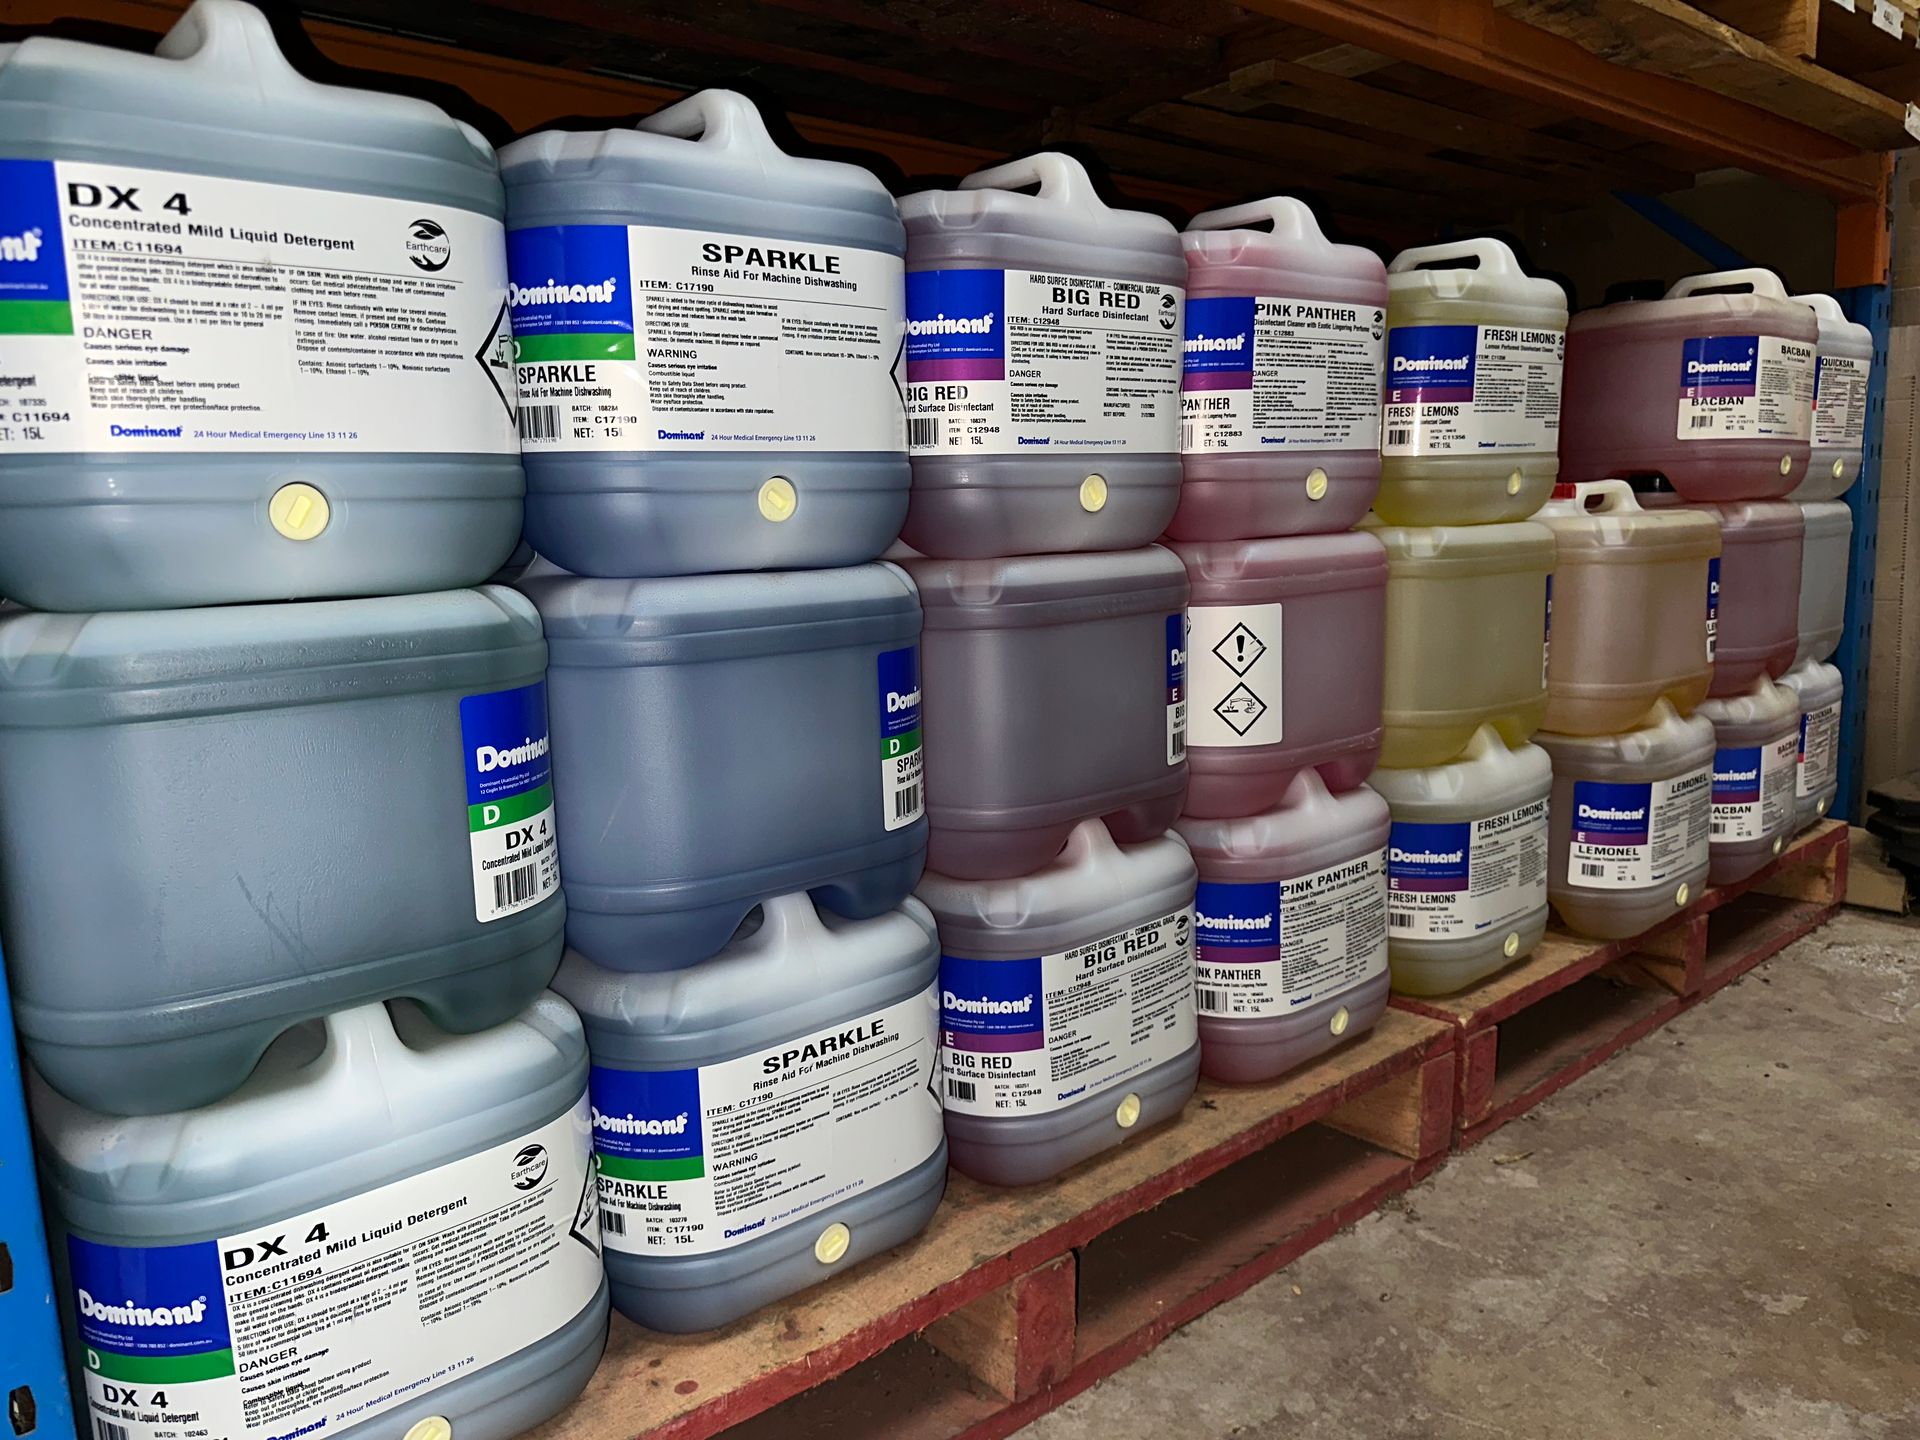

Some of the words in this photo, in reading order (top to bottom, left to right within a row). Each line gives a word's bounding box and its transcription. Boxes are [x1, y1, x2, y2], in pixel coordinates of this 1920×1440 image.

[67, 182, 142, 212] DX
[162, 192, 192, 216] 4
[69, 214, 181, 235] Concentrated
[188, 223, 224, 239] Mild
[230, 228, 277, 246] Liquid
[284, 232, 355, 251] Detergent
[406, 241, 448, 254] Earthcare
[702, 242, 841, 274] SPARKLE
[639, 280, 672, 289] ITEM:
[676, 282, 714, 292] C17190
[692, 266, 720, 278] Rinse
[723, 268, 739, 279] Aid
[743, 270, 759, 281] For
[762, 272, 801, 285] Machine
[804, 276, 858, 291] Dishwashing
[1029, 274, 1046, 284] HARD
[1047, 275, 1067, 287] SURFCE
[1069, 278, 1105, 290] DISINFECTANT
[1113, 281, 1144, 294] COMMERCIAL
[1145, 285, 1161, 296] GRADE
[1052, 287, 1090, 306] BIG
[1099, 292, 1141, 310] RED
[1007, 316, 1031, 324] ITEM:
[1033, 317, 1060, 325] C12948
[1042, 305, 1063, 316] Hard
[1067, 307, 1100, 318] Surface
[1102, 310, 1149, 322] Disinfectant
[1255, 303, 1292, 317] PINK
[1297, 306, 1356, 322] PANTHER
[84, 327, 152, 340] DANGER
[1484, 329, 1518, 342] FRESH
[1521, 332, 1556, 345] LEMONS
[84, 343, 112, 352] Causes
[144, 346, 158, 354] eye
[160, 346, 190, 354] damage
[647, 349, 697, 359] WARNING
[1781, 345, 1811, 358] BACBAN
[86, 358, 114, 367] Causes
[116, 358, 133, 367] skin
[135, 359, 167, 368] irritation
[1393, 355, 1470, 372] Dominant
[1687, 360, 1752, 373] Dominant
[1821, 358, 1854, 369] QUICKSAN
[518, 365, 596, 384] SPARKLE
[1009, 370, 1042, 378] DANGER
[934, 385, 968, 401] RED
[918, 403, 946, 413] Surface
[1691, 397, 1744, 406] BACBAN
[12, 412, 70, 422] C11694
[1421, 406, 1459, 417] LEMONS
[22, 427, 45, 440] 15L
[110, 424, 183, 438] Dominant
[194, 430, 204, 439] 24
[206, 430, 227, 439] Hour
[229, 430, 262, 440] Medical
[263, 430, 306, 441] Emergency
[308, 431, 325, 440] Line
[326, 431, 336, 440] 13
[338, 431, 347, 440] 11
[348, 431, 358, 440] 26
[573, 428, 594, 438] NET:
[657, 429, 705, 440] Dominant
[967, 426, 1000, 434] C12948
[970, 436, 984, 445] 15L
[889, 739, 900, 754] D
[1713, 768, 1757, 782] ominant
[1671, 773, 1708, 794] LEMONEL
[482, 805, 501, 826] D
[1478, 817, 1509, 832] FRESH
[1512, 801, 1544, 822] LEMONS
[1579, 804, 1645, 820] Dominant
[1713, 805, 1751, 814] ACBAN
[505, 824, 534, 850] DX
[539, 818, 547, 836] 4
[1390, 848, 1463, 864] Dominant
[1578, 845, 1639, 856] LEMONEL
[482, 851, 521, 871] Concentrated
[1280, 882, 1313, 896] PINK
[1318, 861, 1369, 887] PANTHER
[1388, 892, 1416, 903] FRESH
[1420, 893, 1456, 904] LEMONS
[1064, 949, 1078, 961] HARD
[1079, 942, 1097, 958] SURFCE
[1097, 932, 1129, 954] DISINFECTANT
[1134, 922, 1162, 939] COMMERCIAL
[1162, 914, 1175, 928] GRADE
[1084, 948, 1116, 969] BIG
[1124, 930, 1159, 953] RED
[1075, 969, 1095, 982] Hard
[1096, 958, 1125, 976] Surface
[1127, 943, 1167, 964] Disinfectant
[1215, 969, 1261, 980] PANTHER
[1068, 980, 1092, 993] C12948
[943, 991, 1033, 1015] Dominant
[945, 1031, 954, 1046] E
[1048, 1030, 1077, 1044] DANGER
[762, 1019, 885, 1075] SPARKLE
[753, 1077, 779, 1091] Rinse
[781, 1070, 796, 1082] Aid
[815, 1052, 850, 1071] Machine
[852, 1032, 900, 1057] Dishwashing
[952, 1053, 976, 1068] BIG
[981, 1056, 1012, 1069] RED
[956, 1068, 985, 1079] Surface
[988, 1068, 1036, 1079] Disinfectant
[1011, 1088, 1042, 1098] C12948
[706, 1104, 736, 1117] ITEM:
[739, 1092, 774, 1108] C17190
[511, 1160, 546, 1180] Earthcare
[712, 1153, 758, 1172] WARNING
[666, 1224, 704, 1233] C17190
[724, 1217, 766, 1239] Dominant
[224, 1235, 288, 1270] DX
[304, 1222, 330, 1244] 4
[226, 1249, 322, 1286] Concentrated
[326, 1236, 356, 1254] Mild
[362, 1220, 402, 1243] Liquid
[407, 1196, 468, 1226] Detergent
[648, 1235, 666, 1245] NET:
[674, 1235, 694, 1244] 15L
[78, 1288, 207, 1327] Dominant
[87, 1348, 100, 1370] D
[239, 1346, 298, 1374] DANGER
[103, 1384, 139, 1408] DX
[150, 1391, 169, 1409] 4
[336, 1412, 345, 1421] 24
[346, 1406, 364, 1418] Hour
[366, 1393, 393, 1410] Medical
[394, 1380, 431, 1400] Emergency
[432, 1369, 446, 1382] Line
[448, 1364, 456, 1373] 13
[458, 1360, 466, 1369] 11
[466, 1356, 475, 1365] 26
[121, 1408, 136, 1422] Mild
[138, 1410, 159, 1426] Liquid
[161, 1411, 200, 1425] Detergent
